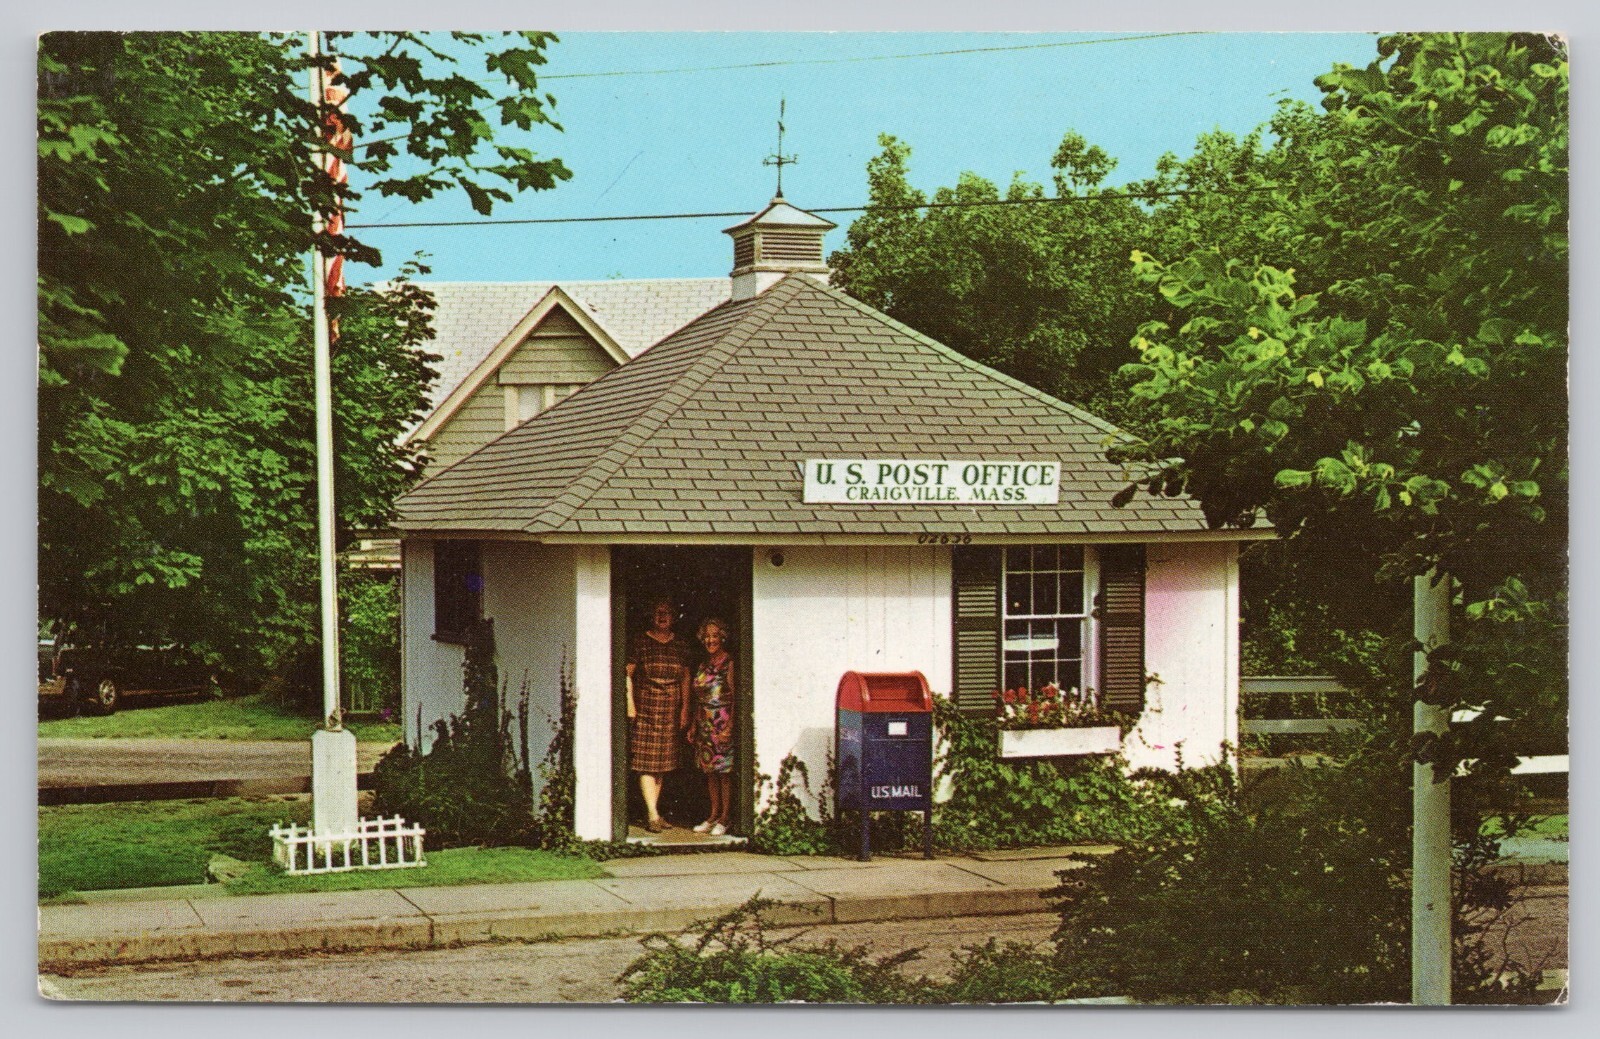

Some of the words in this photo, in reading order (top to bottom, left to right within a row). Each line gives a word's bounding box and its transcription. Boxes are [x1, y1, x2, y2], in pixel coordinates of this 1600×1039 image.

[816, 463, 836, 485] U.
[845, 463, 866, 485] S.
[876, 463, 949, 486] POST
[962, 464, 1055, 486] OFFICE
[968, 487, 1027, 501] MASS.
